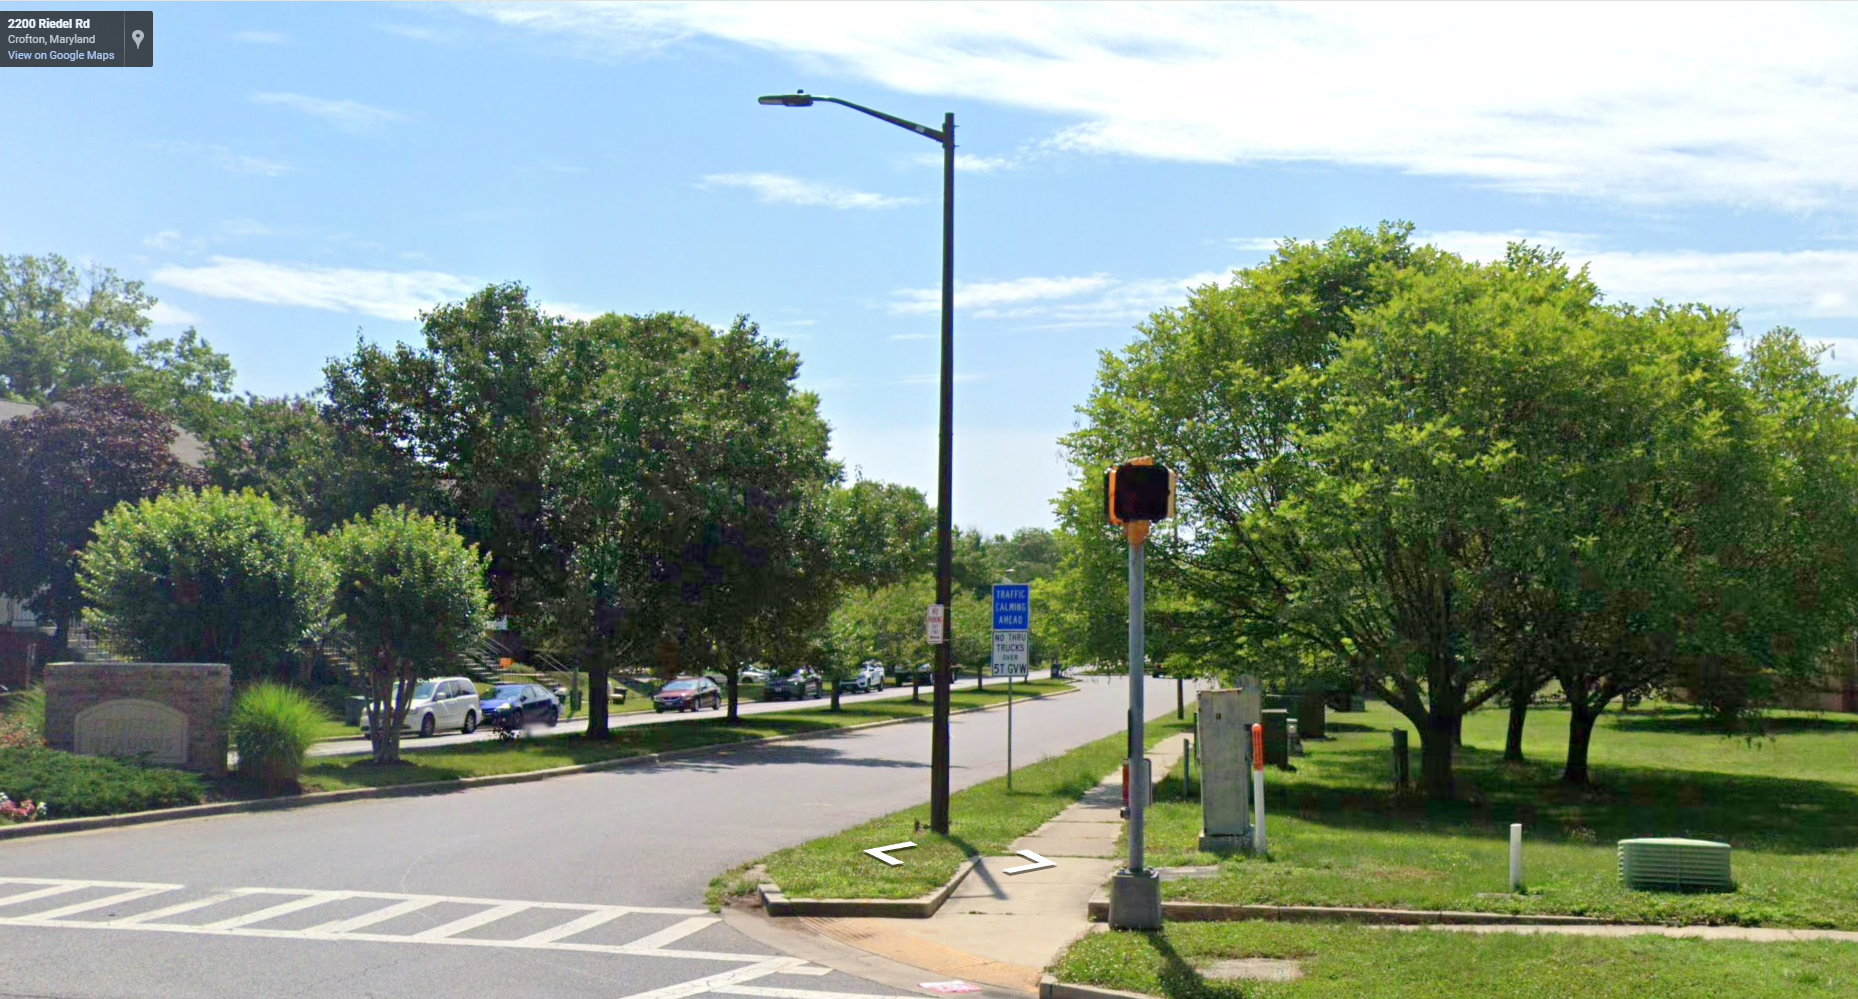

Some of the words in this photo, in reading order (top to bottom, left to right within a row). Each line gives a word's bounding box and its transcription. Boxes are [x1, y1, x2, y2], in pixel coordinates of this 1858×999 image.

[997, 589, 1026, 599] TRAFFIC
[995, 602, 1027, 612] CALMING
[999, 615, 1023, 624] AHEAD
[994, 633, 1005, 642] NO
[1008, 633, 1027, 642] THRU
[996, 643, 1025, 653] TRUCKS
[993, 663, 1005, 675] 5T
[1007, 663, 1027, 675] GVW
